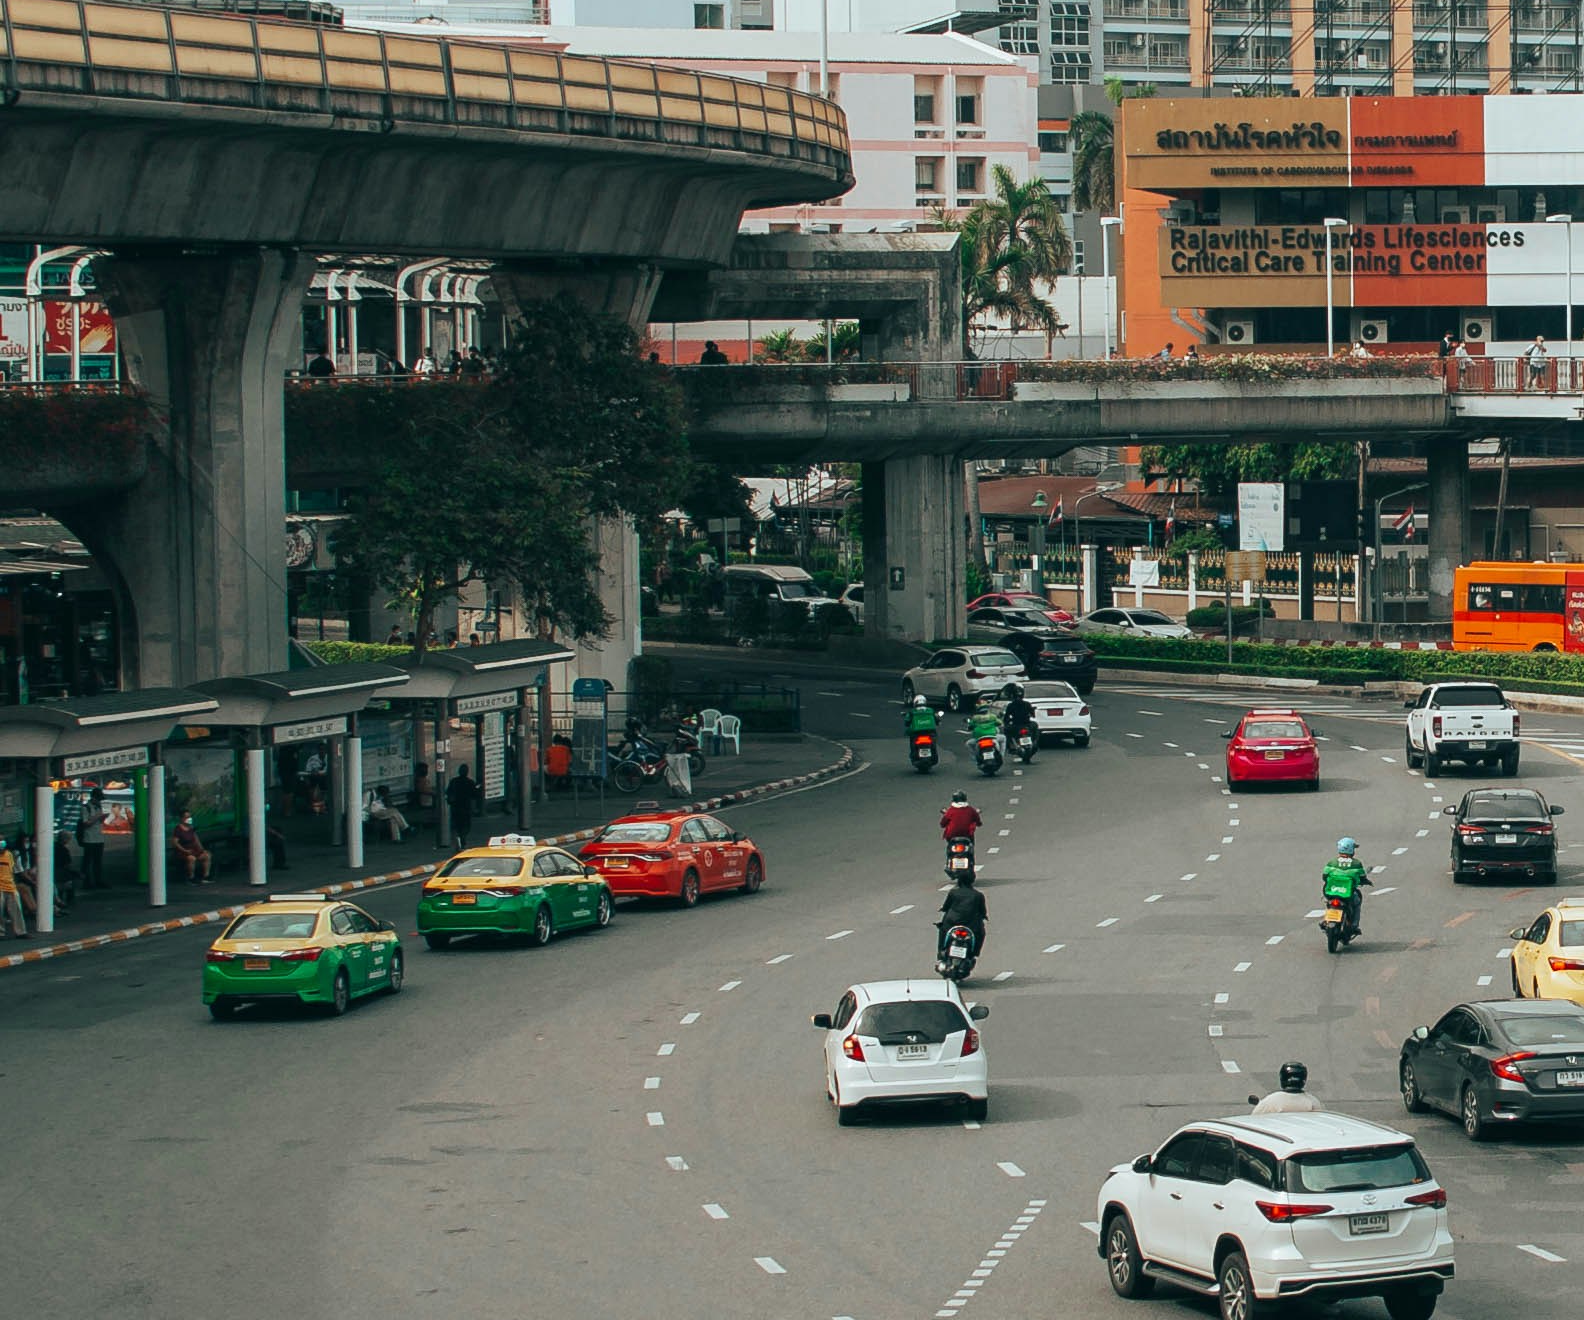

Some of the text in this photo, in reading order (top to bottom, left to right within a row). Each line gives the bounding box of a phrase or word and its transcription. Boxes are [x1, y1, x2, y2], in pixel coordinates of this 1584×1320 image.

[1156, 122, 1341, 150] สถาบันโรคหัวใจ
[1210, 166, 1415, 177] INSTITUTE OF CARDIOVASCULAR DISEASES
[1170, 227, 1525, 253] Rajavithi-Edwards Lifesciences
[1171, 249, 1485, 277] Critical Care Training Center
